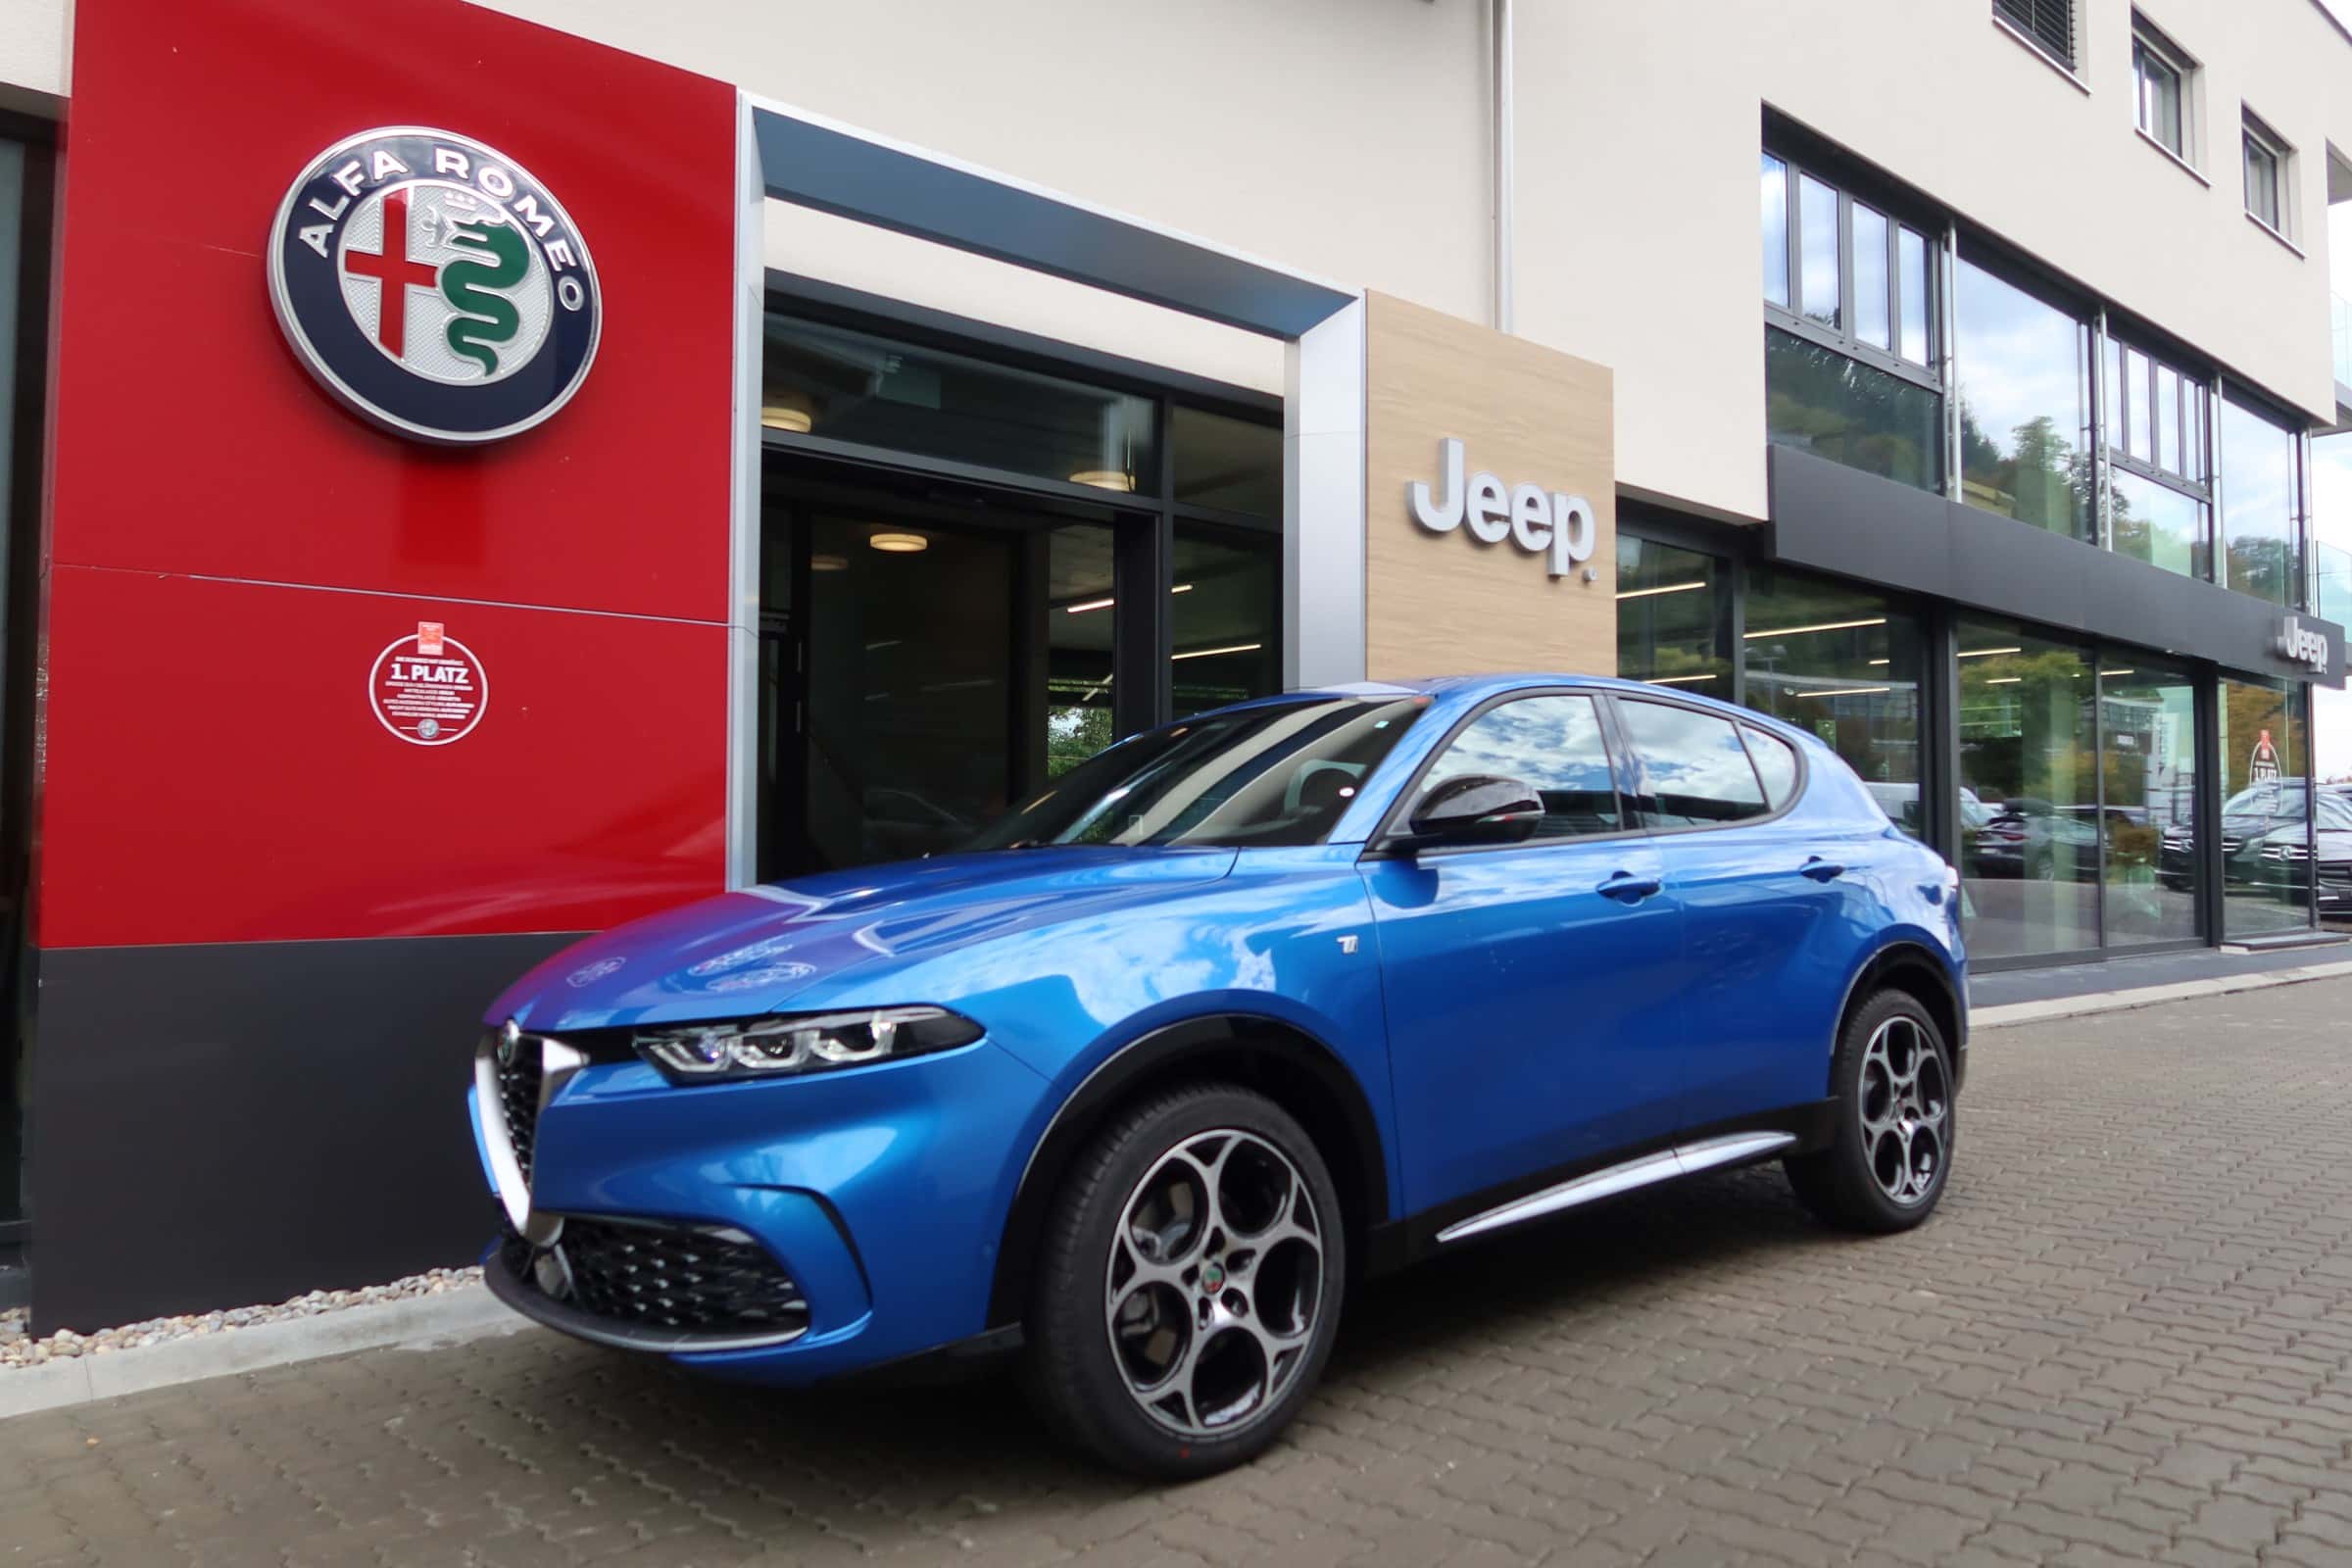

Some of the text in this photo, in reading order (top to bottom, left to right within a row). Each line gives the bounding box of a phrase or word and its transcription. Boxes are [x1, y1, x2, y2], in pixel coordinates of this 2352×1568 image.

[299, 147, 585, 312] ALFA ROMEO
[1405, 437, 1595, 576] Jeep
[391, 663, 469, 684] 1. PLATZ
[2278, 616, 2328, 672] Jeep
